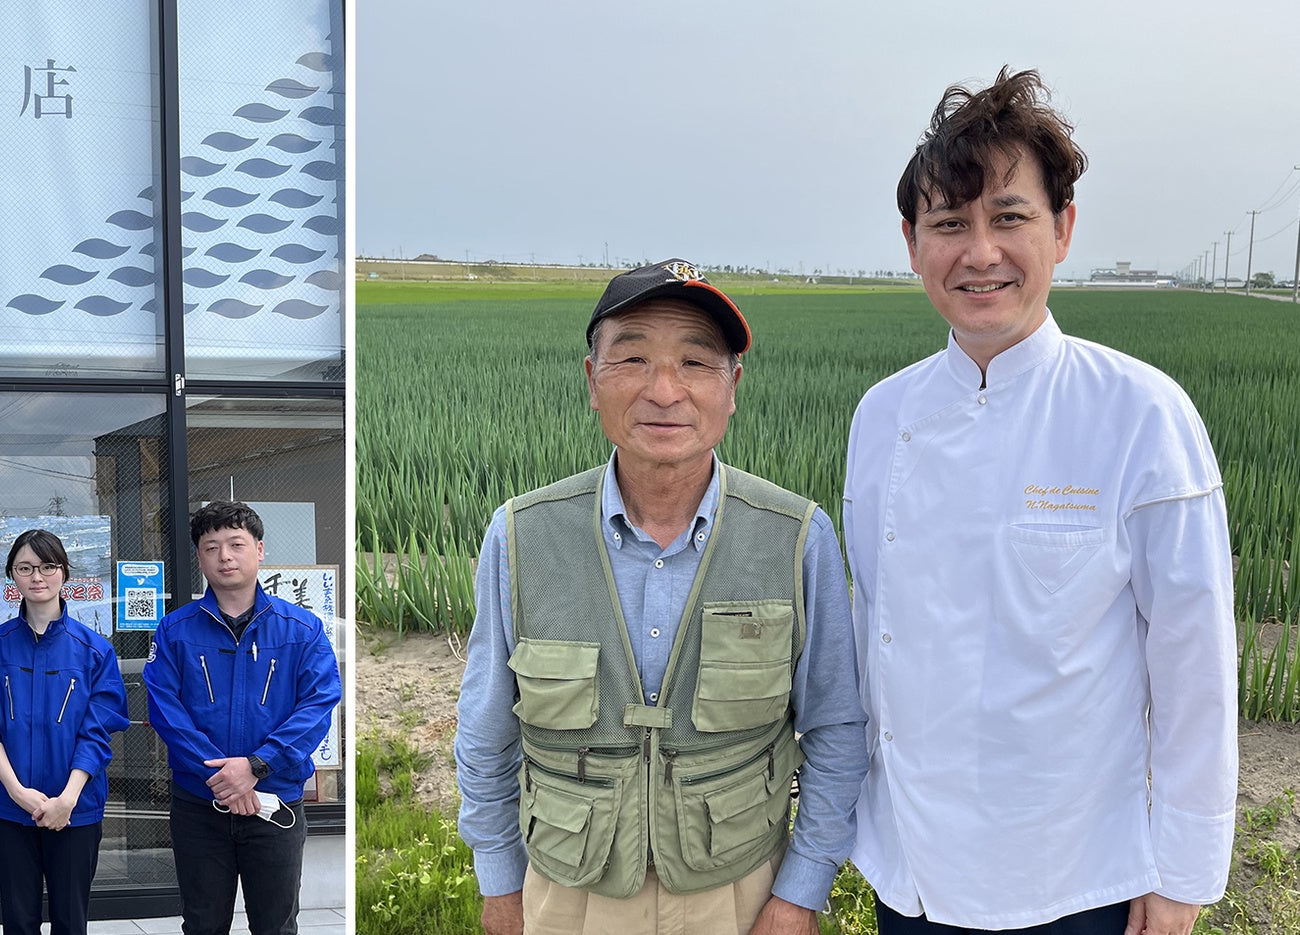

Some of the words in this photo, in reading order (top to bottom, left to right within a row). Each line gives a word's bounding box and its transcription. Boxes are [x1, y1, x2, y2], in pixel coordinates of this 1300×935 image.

[1024, 484, 1049, 496] Chef
[1050, 486, 1060, 495] de
[1062, 485, 1099, 496] Cuisine
